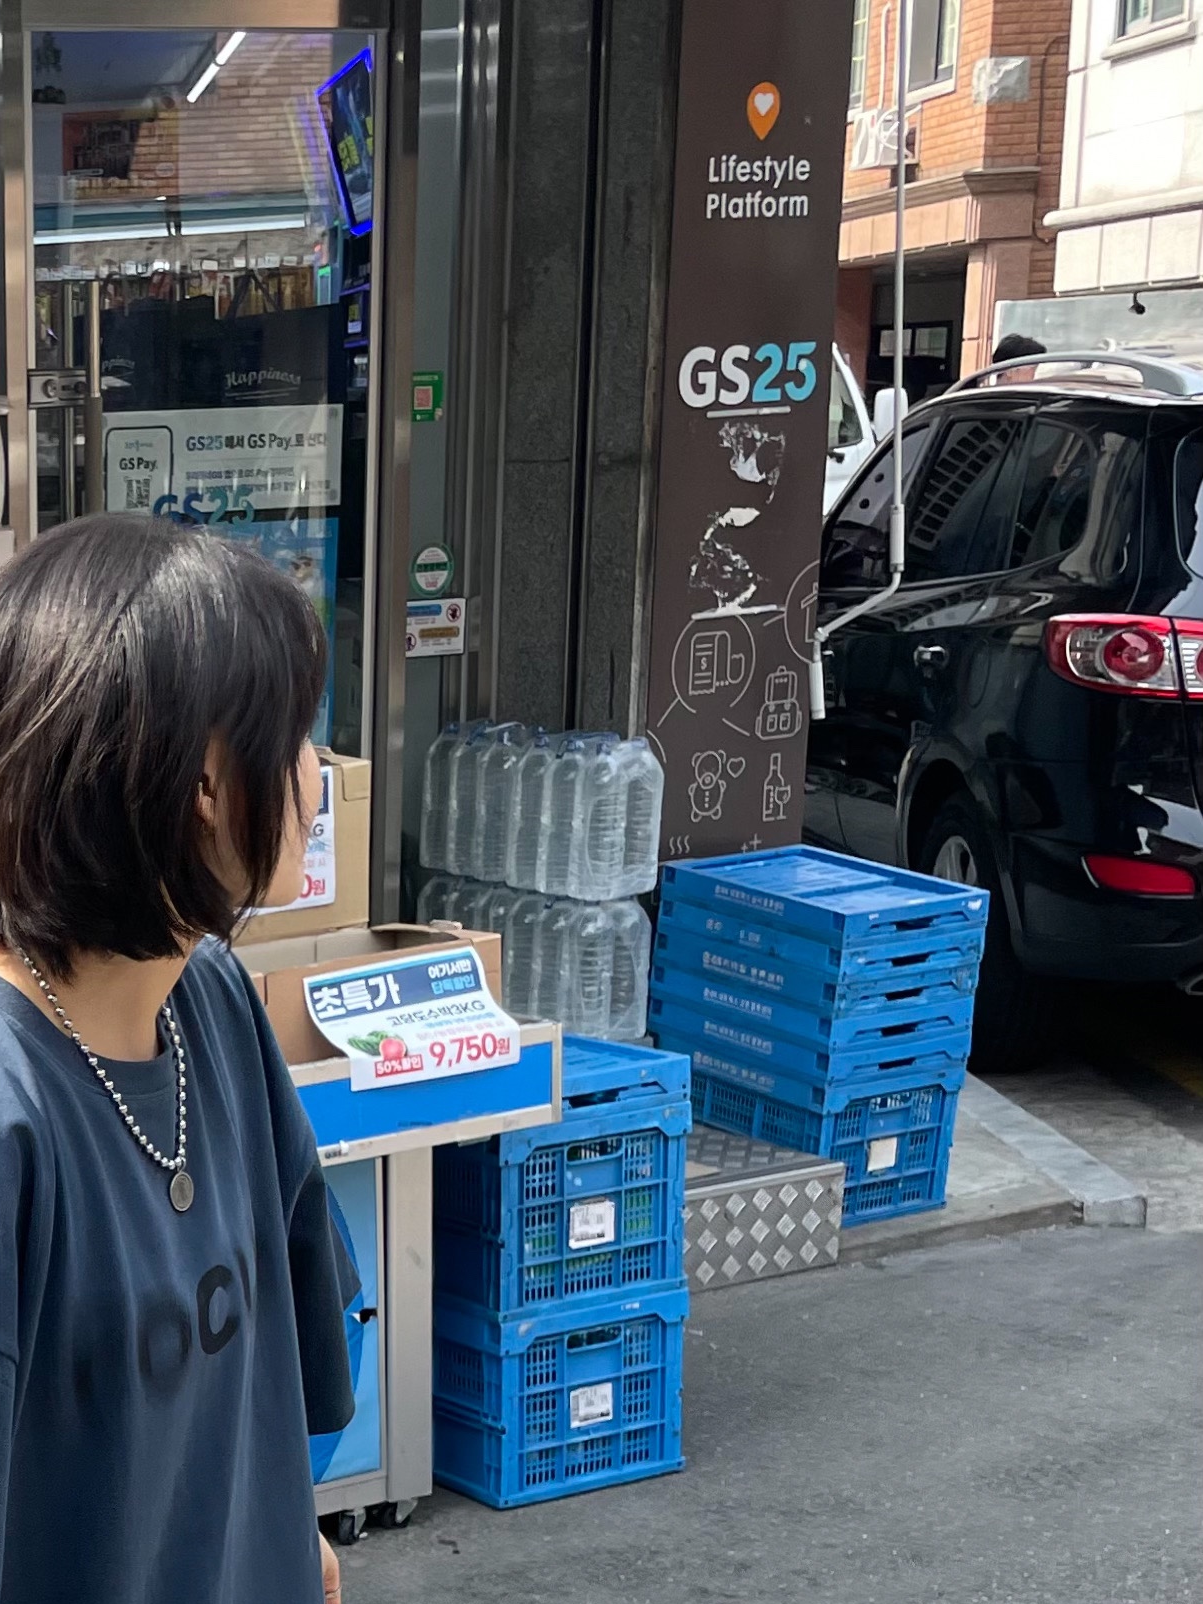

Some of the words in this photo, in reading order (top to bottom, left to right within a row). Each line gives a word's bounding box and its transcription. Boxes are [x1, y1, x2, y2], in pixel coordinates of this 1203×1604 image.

[708, 154, 811, 189] Lifestyle
[705, 190, 810, 219] Platform
[225, 366, 301, 390] Happiness
[678, 341, 817, 408] GS25
[119, 457, 135, 470] GS
[153, 486, 255, 527] GS25
[427, 959, 473, 979] 여기서만
[312, 973, 401, 1020] 초특가
[376, 1054, 423, 1076] 50%할인
[429, 1032, 510, 1069] 9,750원
